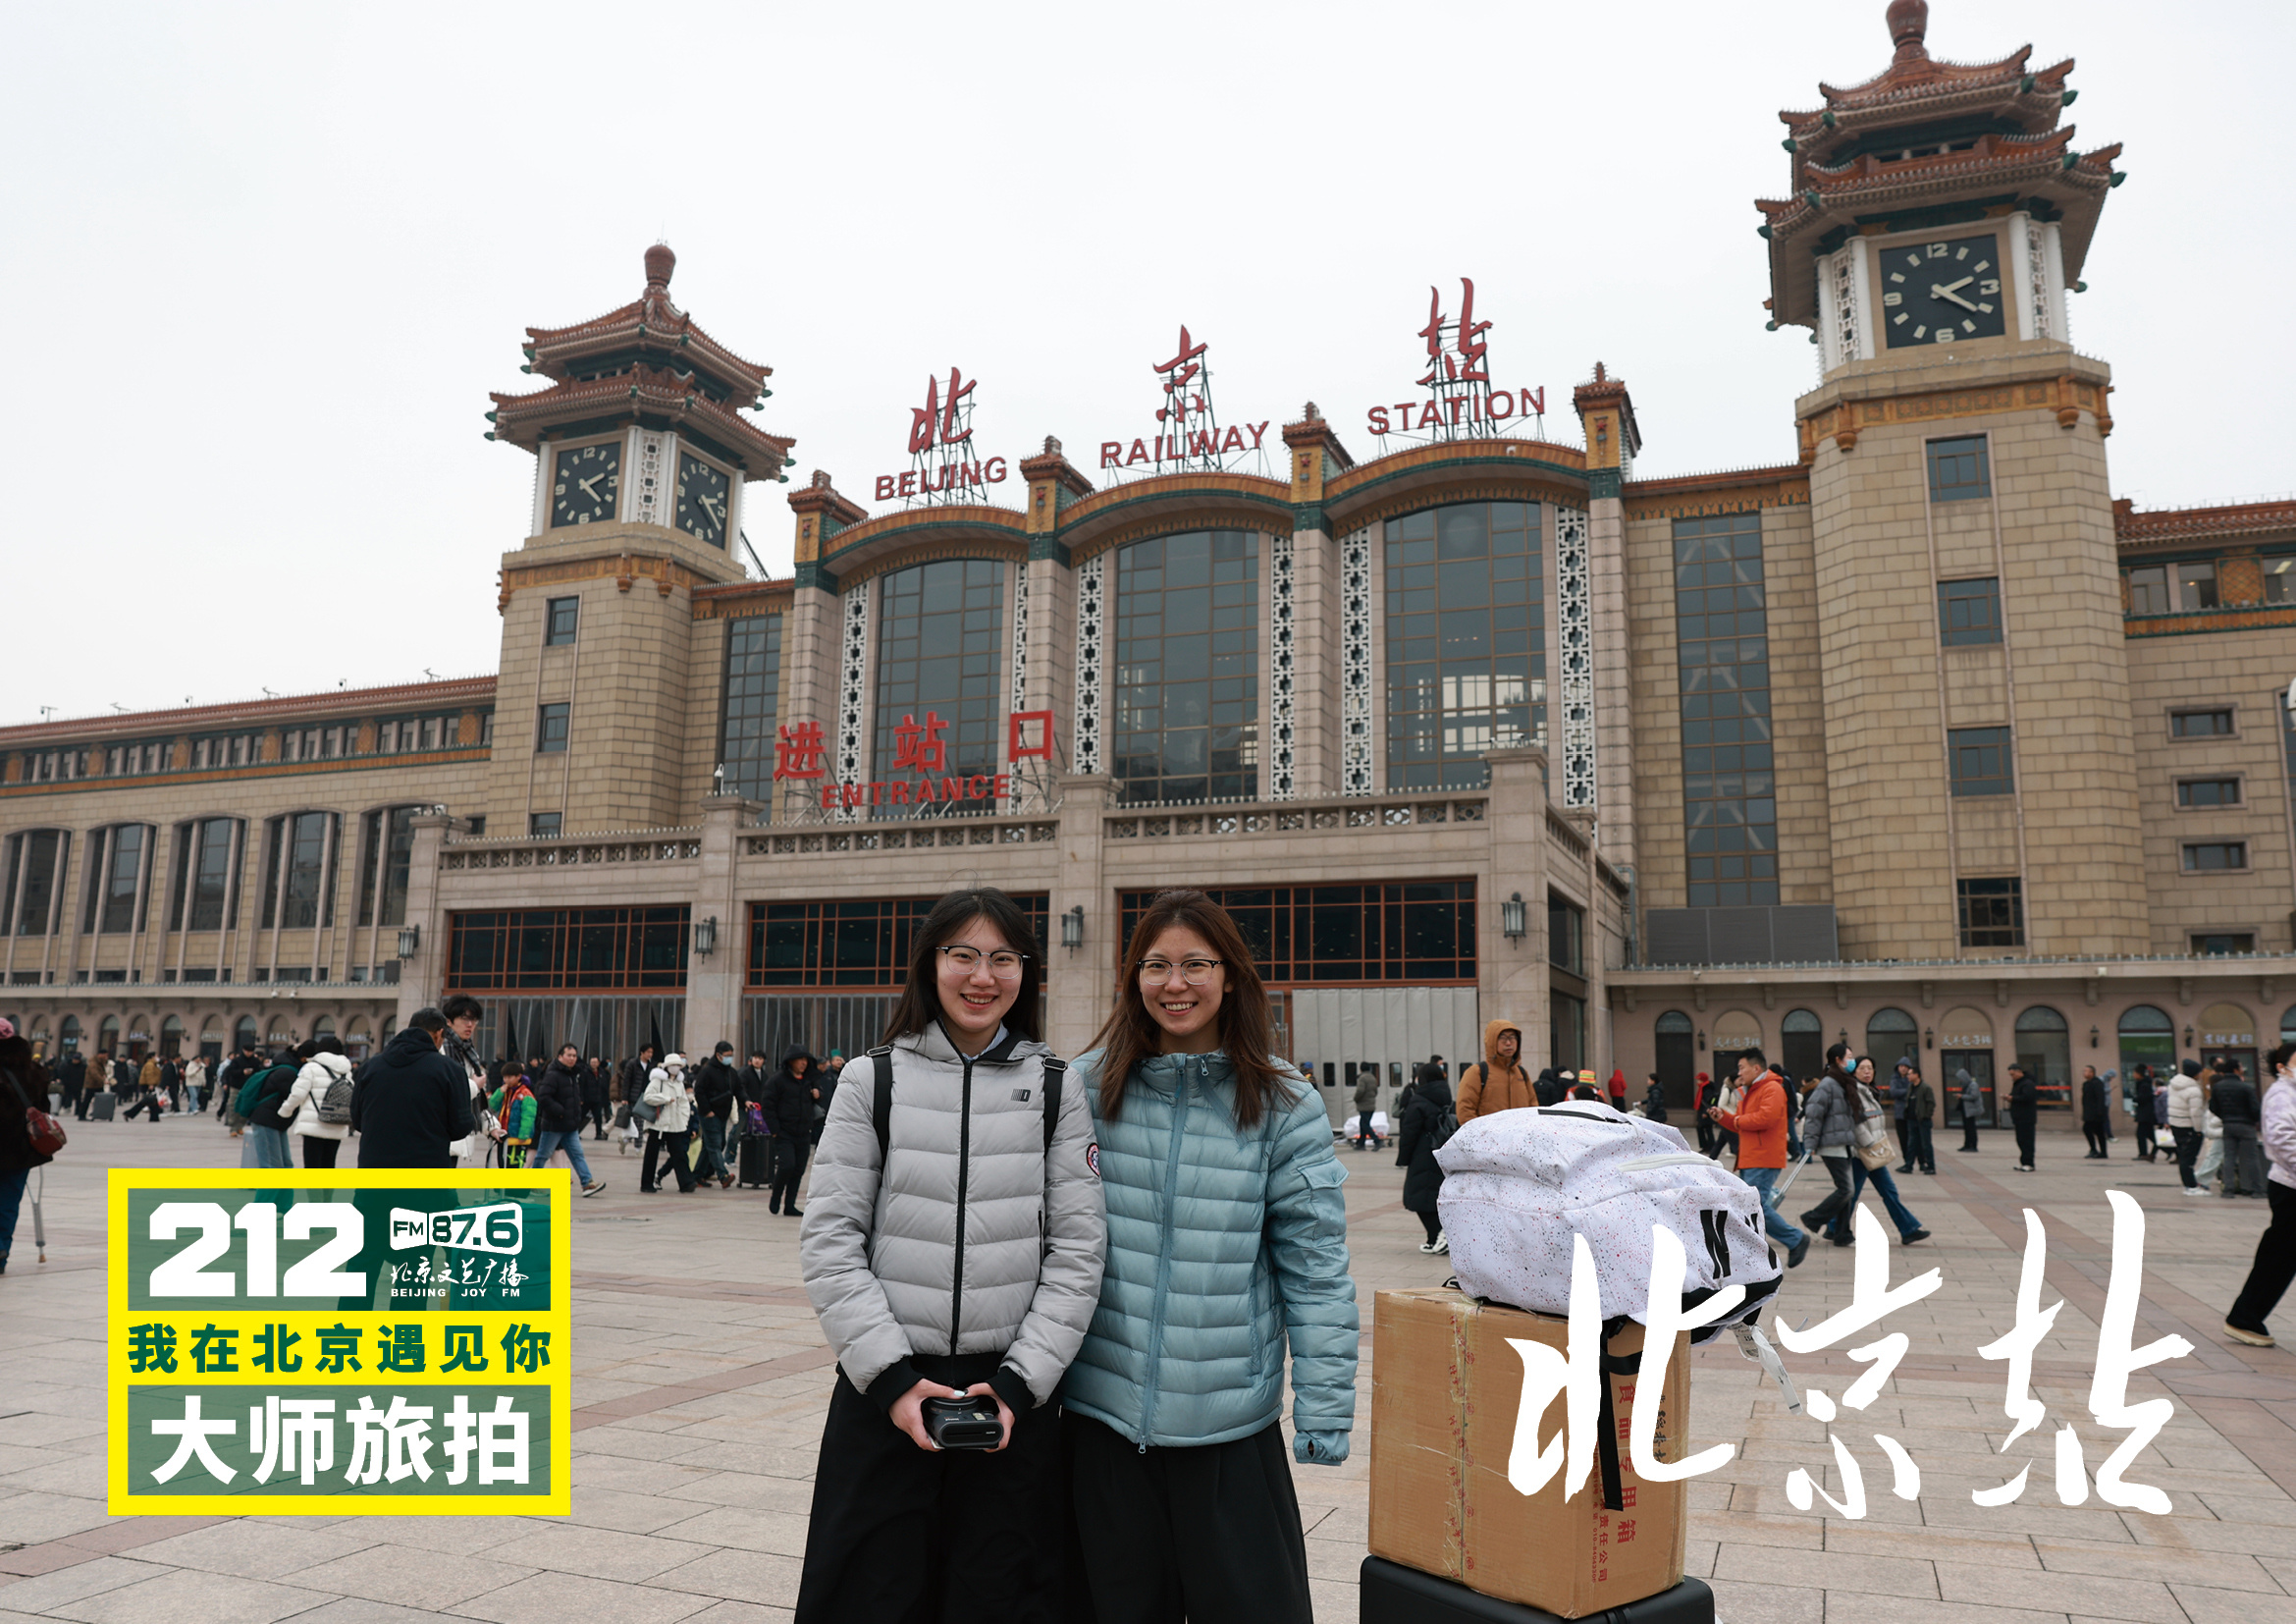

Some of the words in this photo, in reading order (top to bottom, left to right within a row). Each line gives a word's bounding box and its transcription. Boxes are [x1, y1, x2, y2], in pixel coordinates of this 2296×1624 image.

[1926, 243, 1949, 259] 12
[1980, 279, 2000, 296] 3
[1884, 292, 1902, 306] 9
[1935, 328, 1955, 344] 6
[908, 271, 1493, 455] 北京站
[876, 456, 1007, 501] BEIJING
[1100, 420, 1270, 469] RAILWAY
[1367, 386, 1545, 435] STATION
[583, 447, 596, 460] 12
[699, 462, 709, 477] 12
[578, 513, 590, 524] 6
[773, 710, 1055, 782] 进站口
[821, 774, 1010, 809] ENTRANCE
